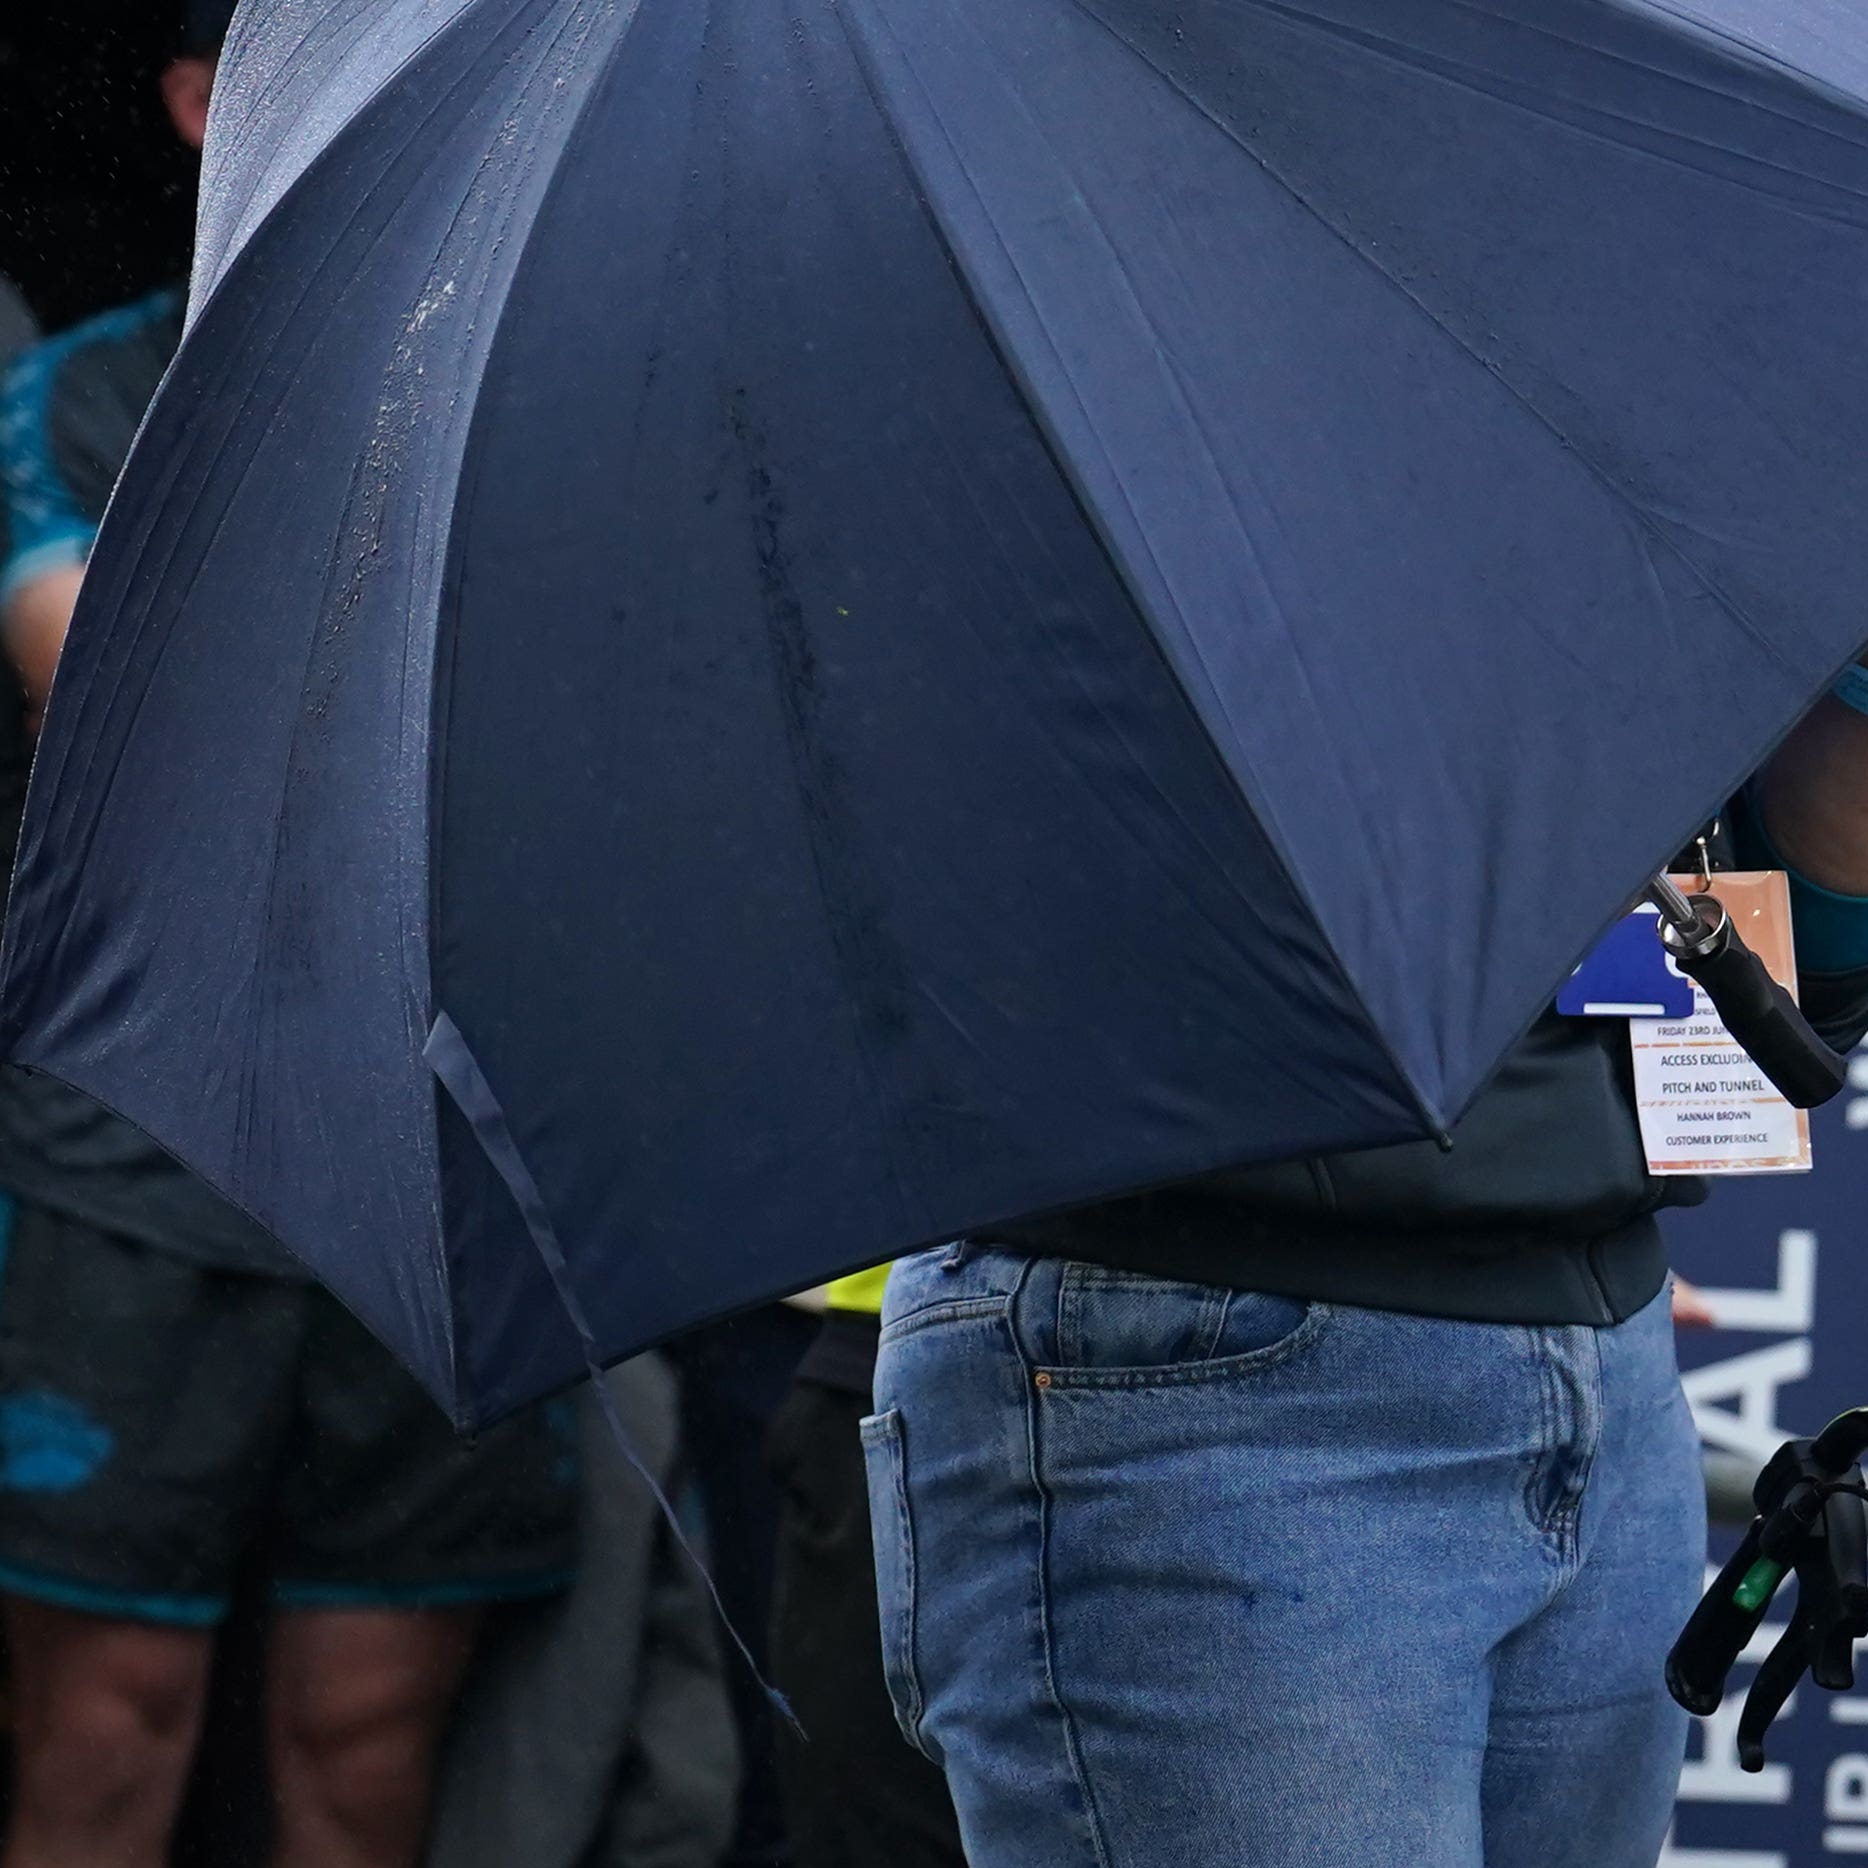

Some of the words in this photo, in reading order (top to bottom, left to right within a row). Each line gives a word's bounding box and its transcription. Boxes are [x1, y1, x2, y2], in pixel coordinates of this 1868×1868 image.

[1657, 1026, 1686, 1036] FRIDAY
[1661, 1054, 1698, 1066] ACCESS
[1662, 1082, 1691, 1094] PITCH
[1694, 1081, 1718, 1093] AND
[1719, 1079, 1765, 1092] TUNNEL
[1677, 1112, 1714, 1122] HANNAH
[1717, 1111, 1752, 1121] BROWN
[1666, 1136, 1712, 1146] CUSTOMER
[1714, 1133, 1768, 1144] EXPERIENCE
